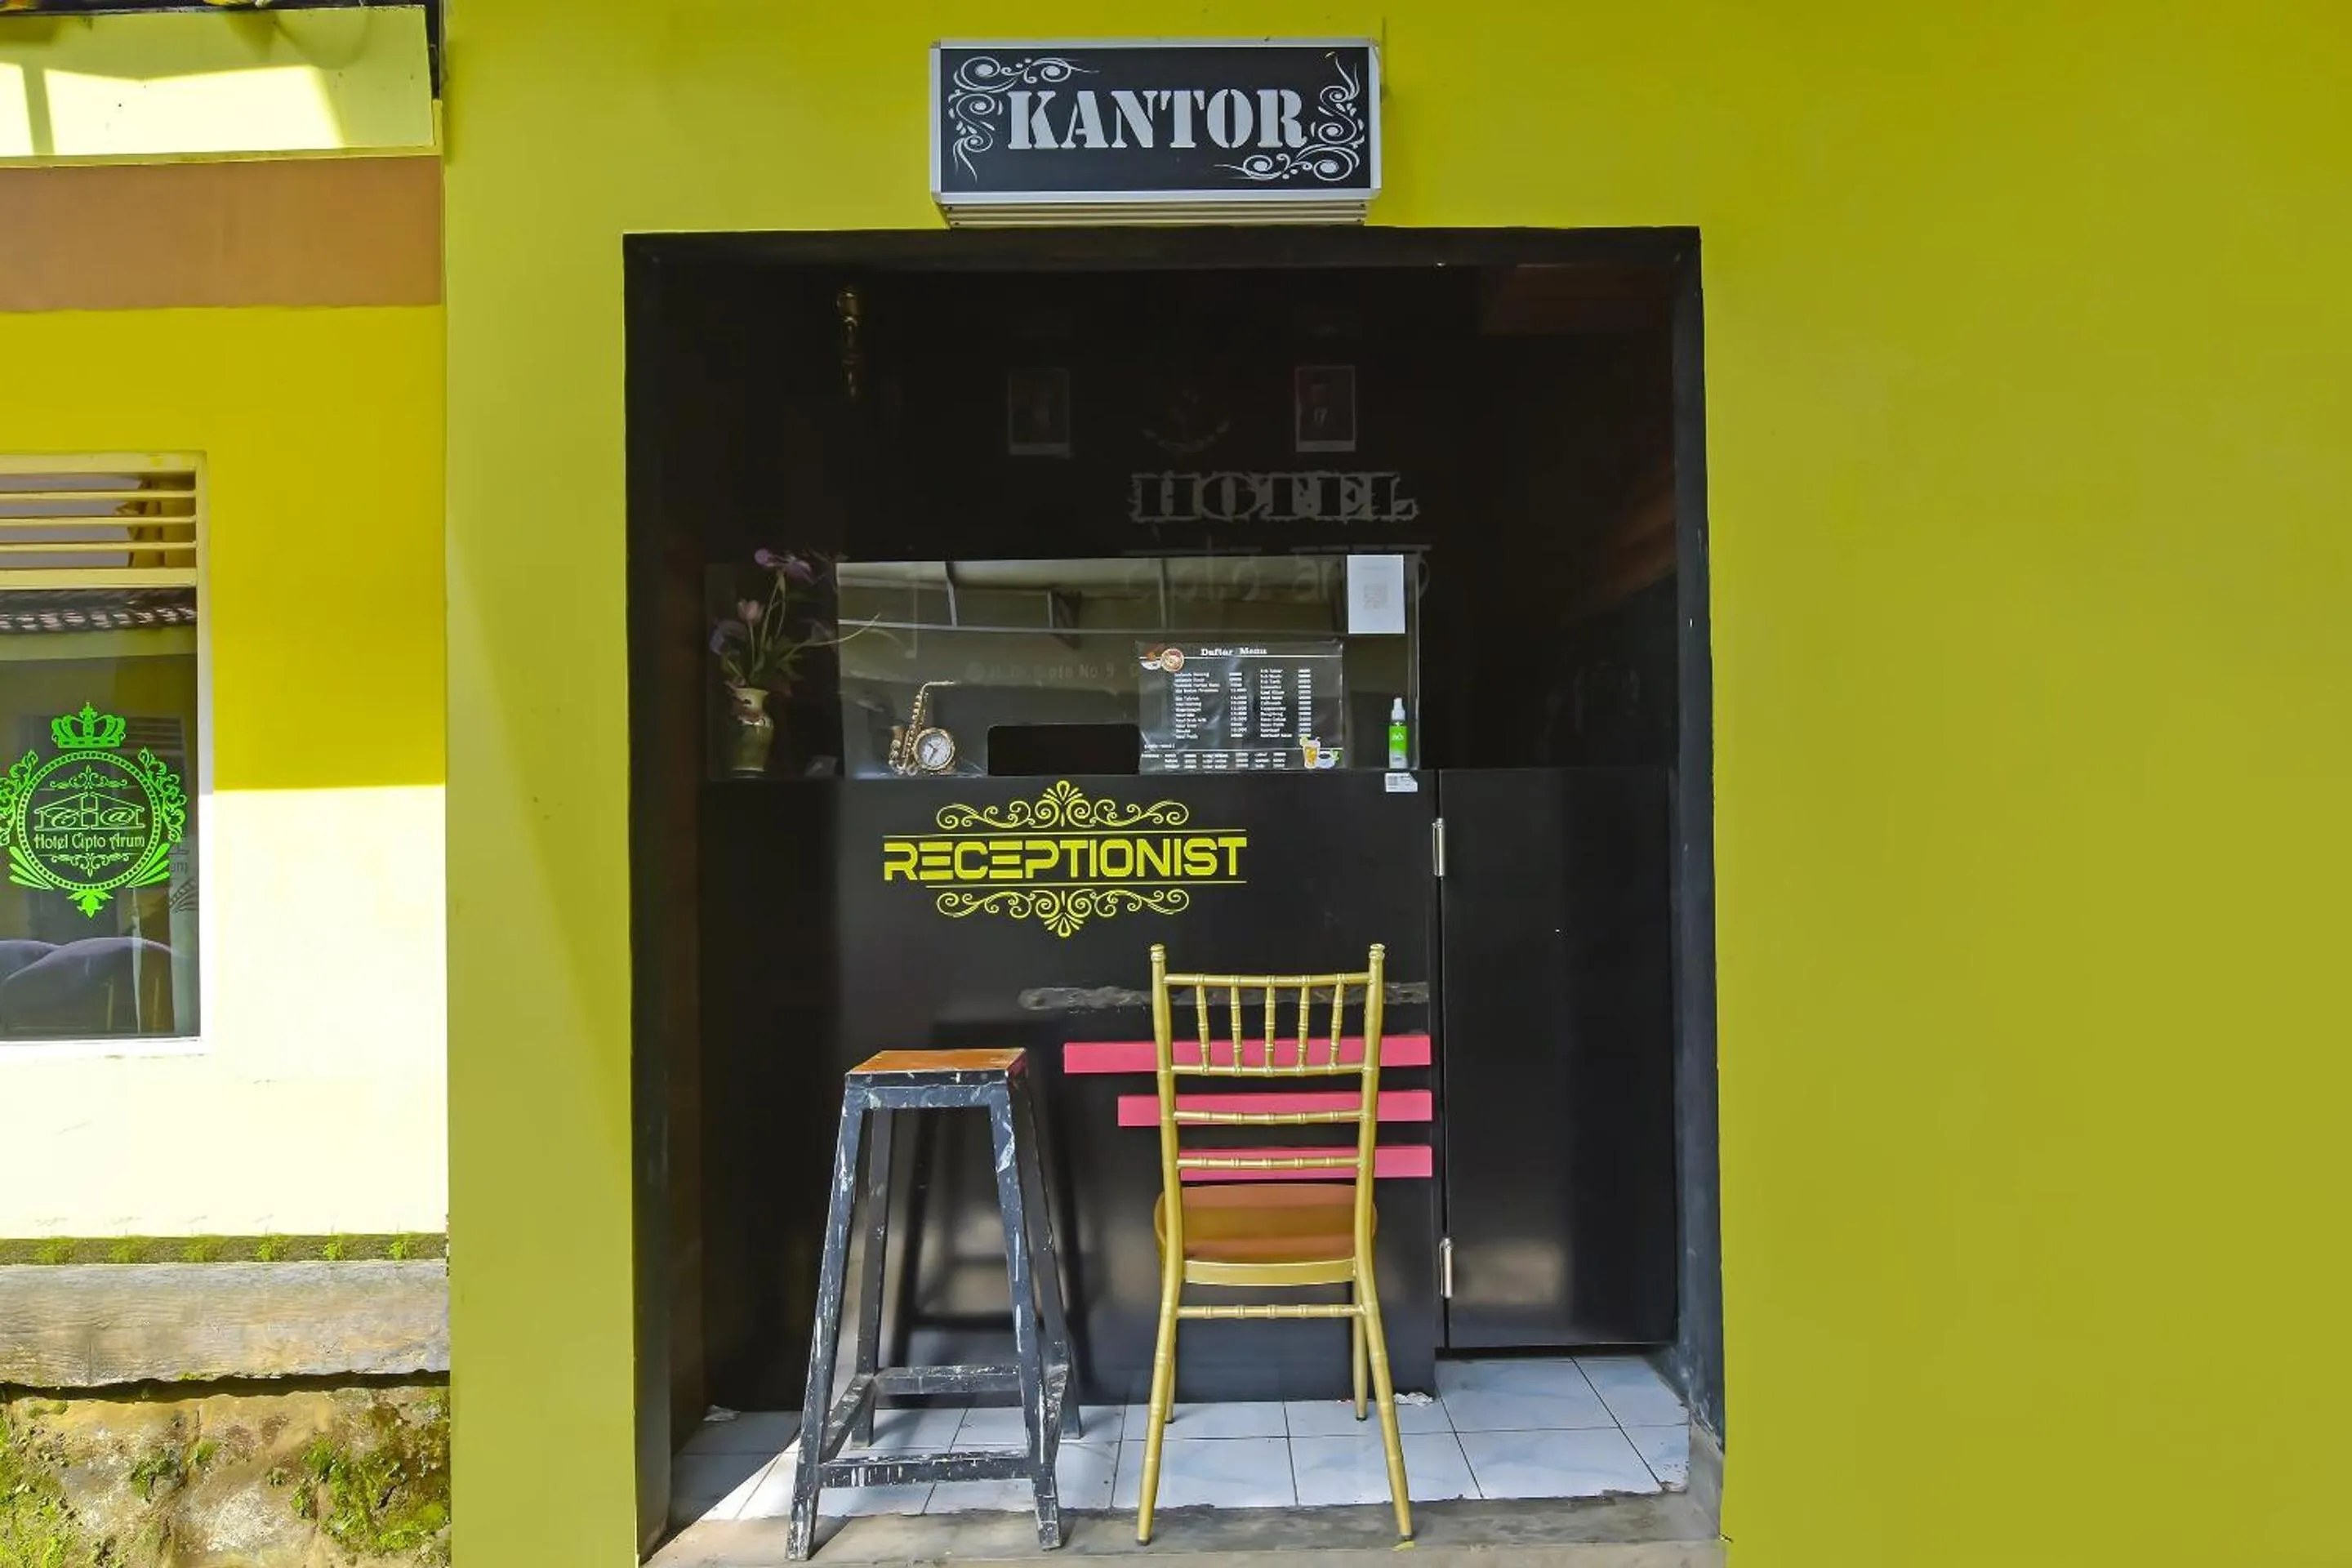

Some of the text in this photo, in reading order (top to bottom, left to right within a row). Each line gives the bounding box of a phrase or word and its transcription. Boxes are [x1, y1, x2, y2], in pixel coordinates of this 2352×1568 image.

[1006, 89, 1308, 149] KANTOR
[1127, 470, 1420, 523] HOTEL
[1240, 647, 1268, 655] Menu
[33, 832, 145, 852] Hotel Cipto Arum
[884, 837, 1247, 880] RECEPTIONIST
